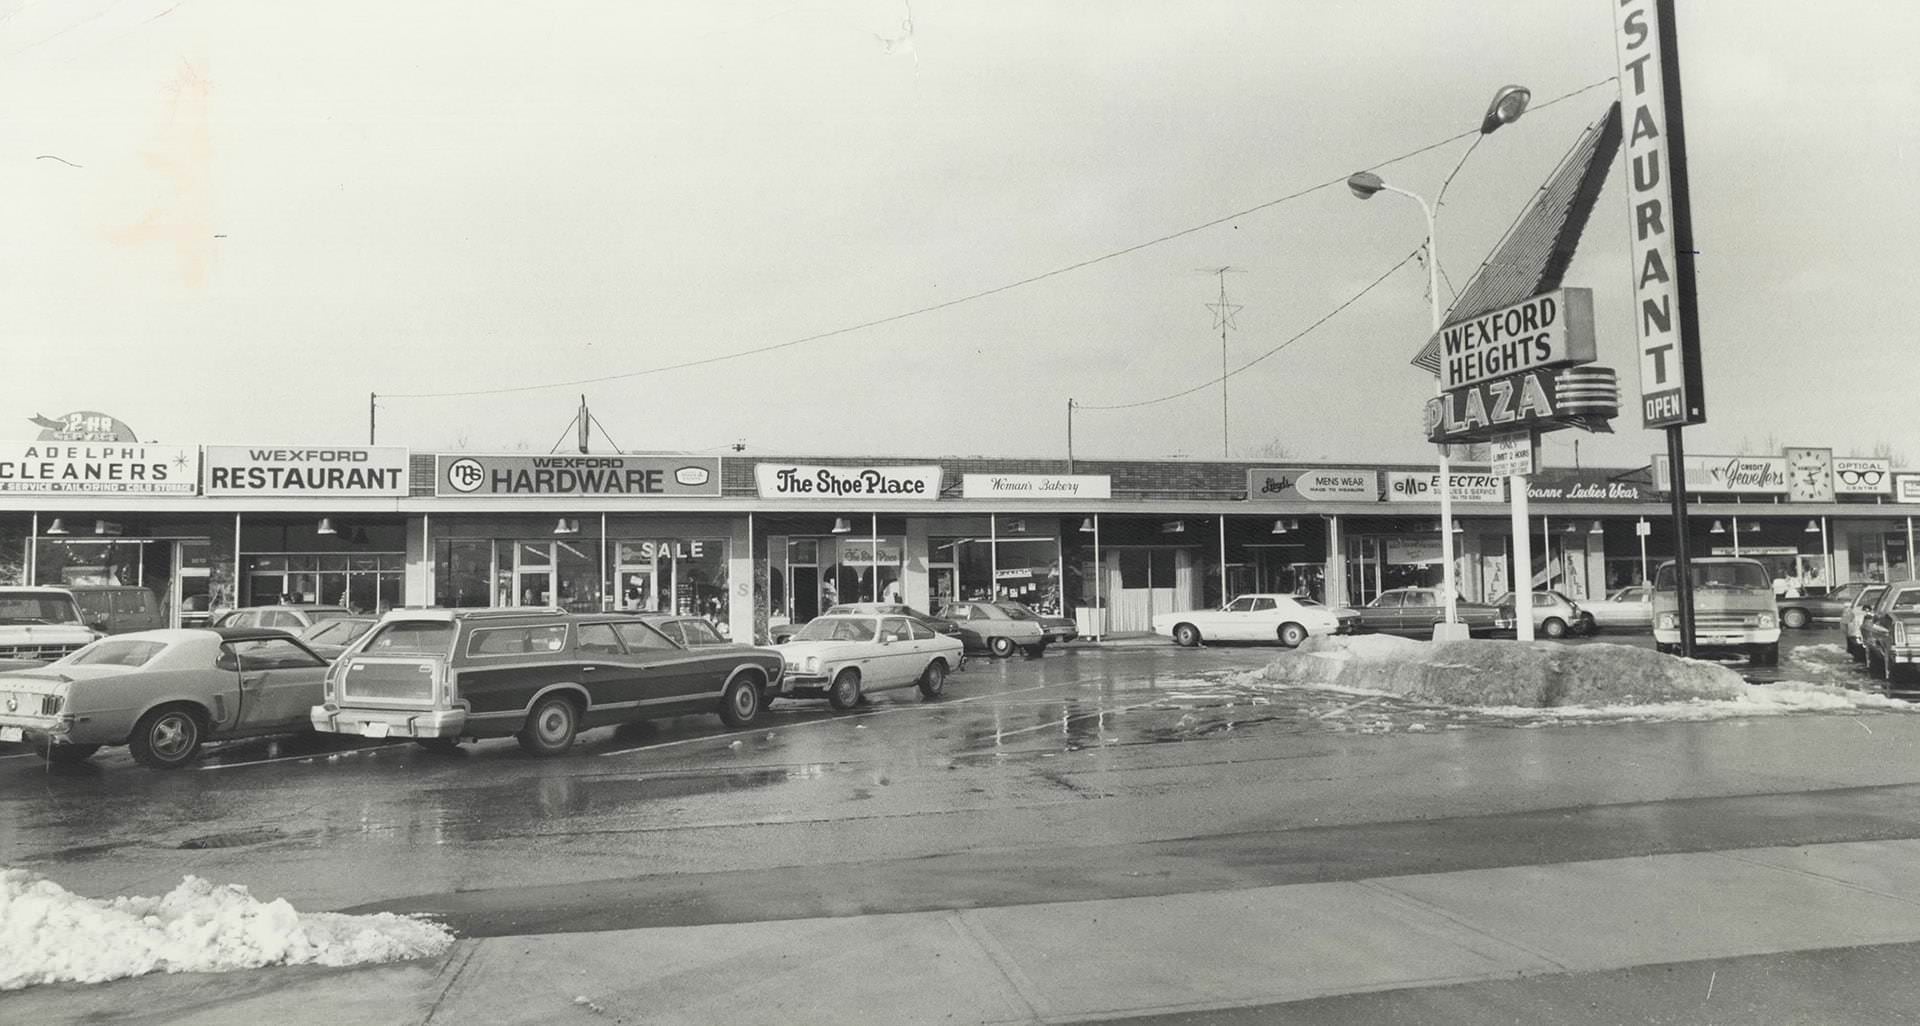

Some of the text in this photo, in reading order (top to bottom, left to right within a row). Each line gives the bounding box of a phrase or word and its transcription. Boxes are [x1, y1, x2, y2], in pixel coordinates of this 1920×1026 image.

[1620, 0, 1674, 385] STAURANT
[1444, 297, 1557, 357] WEXFORD
[1449, 332, 1552, 386] HEIGHTS
[1424, 374, 1553, 439] PLAZA
[1646, 393, 1680, 420] OPEN
[24, 446, 145, 459] ADELPHI
[249, 450, 369, 462] WEXFORD
[0, 462, 168, 480] CLEANERS
[533, 458, 624, 468] WEXFORD
[1740, 463, 1763, 471] CREDIT
[1838, 462, 1884, 470] OPTICAL
[211, 467, 402, 489] RESTAURANT
[491, 469, 664, 493] HARDWARE
[776, 468, 925, 496] The Shoe Place
[1340, 477, 1364, 487] WEAR
[1725, 458, 1785, 489] Jewellers
[1038, 479, 1079, 495] Bakery
[1394, 475, 1500, 495] GMD EECTRIC
[1566, 483, 1607, 499] Ladies
[1608, 483, 1640, 499] Wear
[641, 542, 704, 559] SALE
[1566, 555, 1584, 596] SALE
